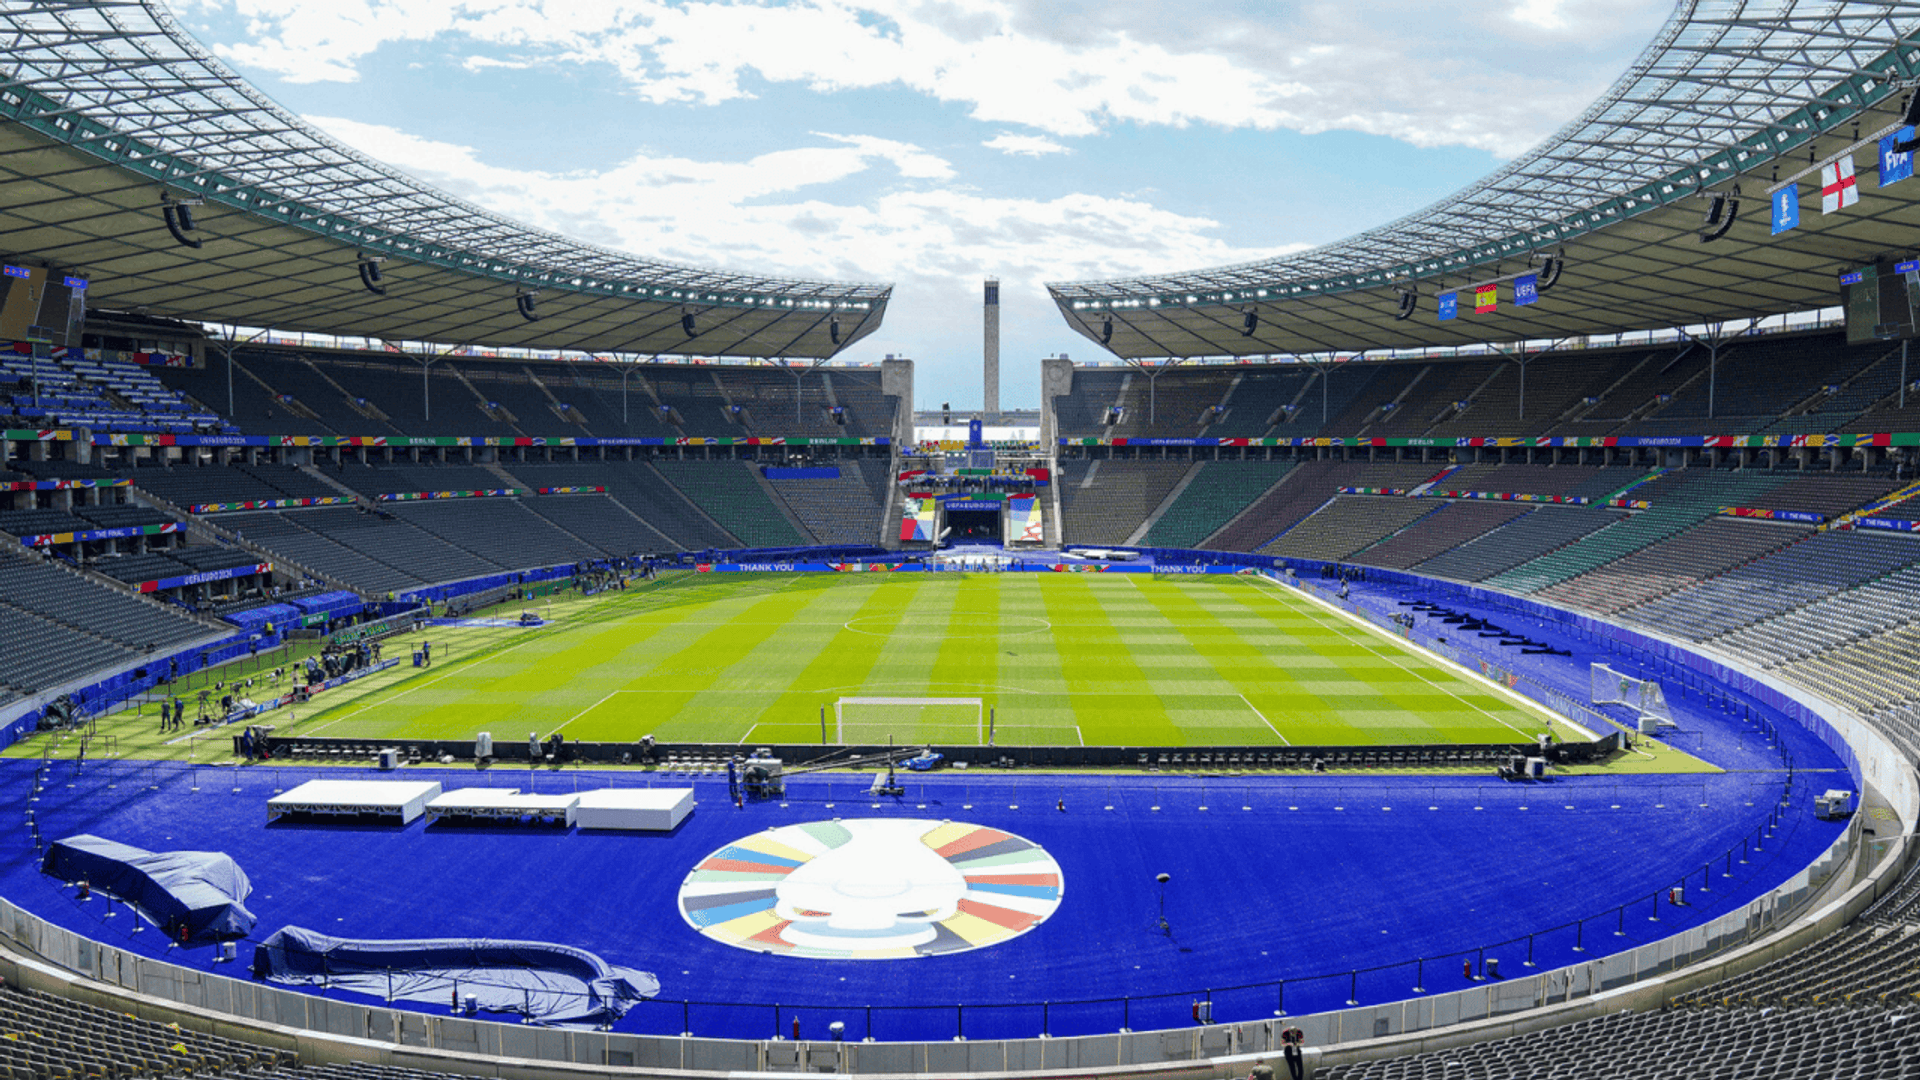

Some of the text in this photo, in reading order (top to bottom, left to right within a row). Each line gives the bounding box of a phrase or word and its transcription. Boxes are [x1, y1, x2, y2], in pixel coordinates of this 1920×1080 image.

[1516, 284, 1536, 297] UEFA
[739, 563, 794, 571] THANK YOU
[1150, 565, 1206, 573] THANK YOU
